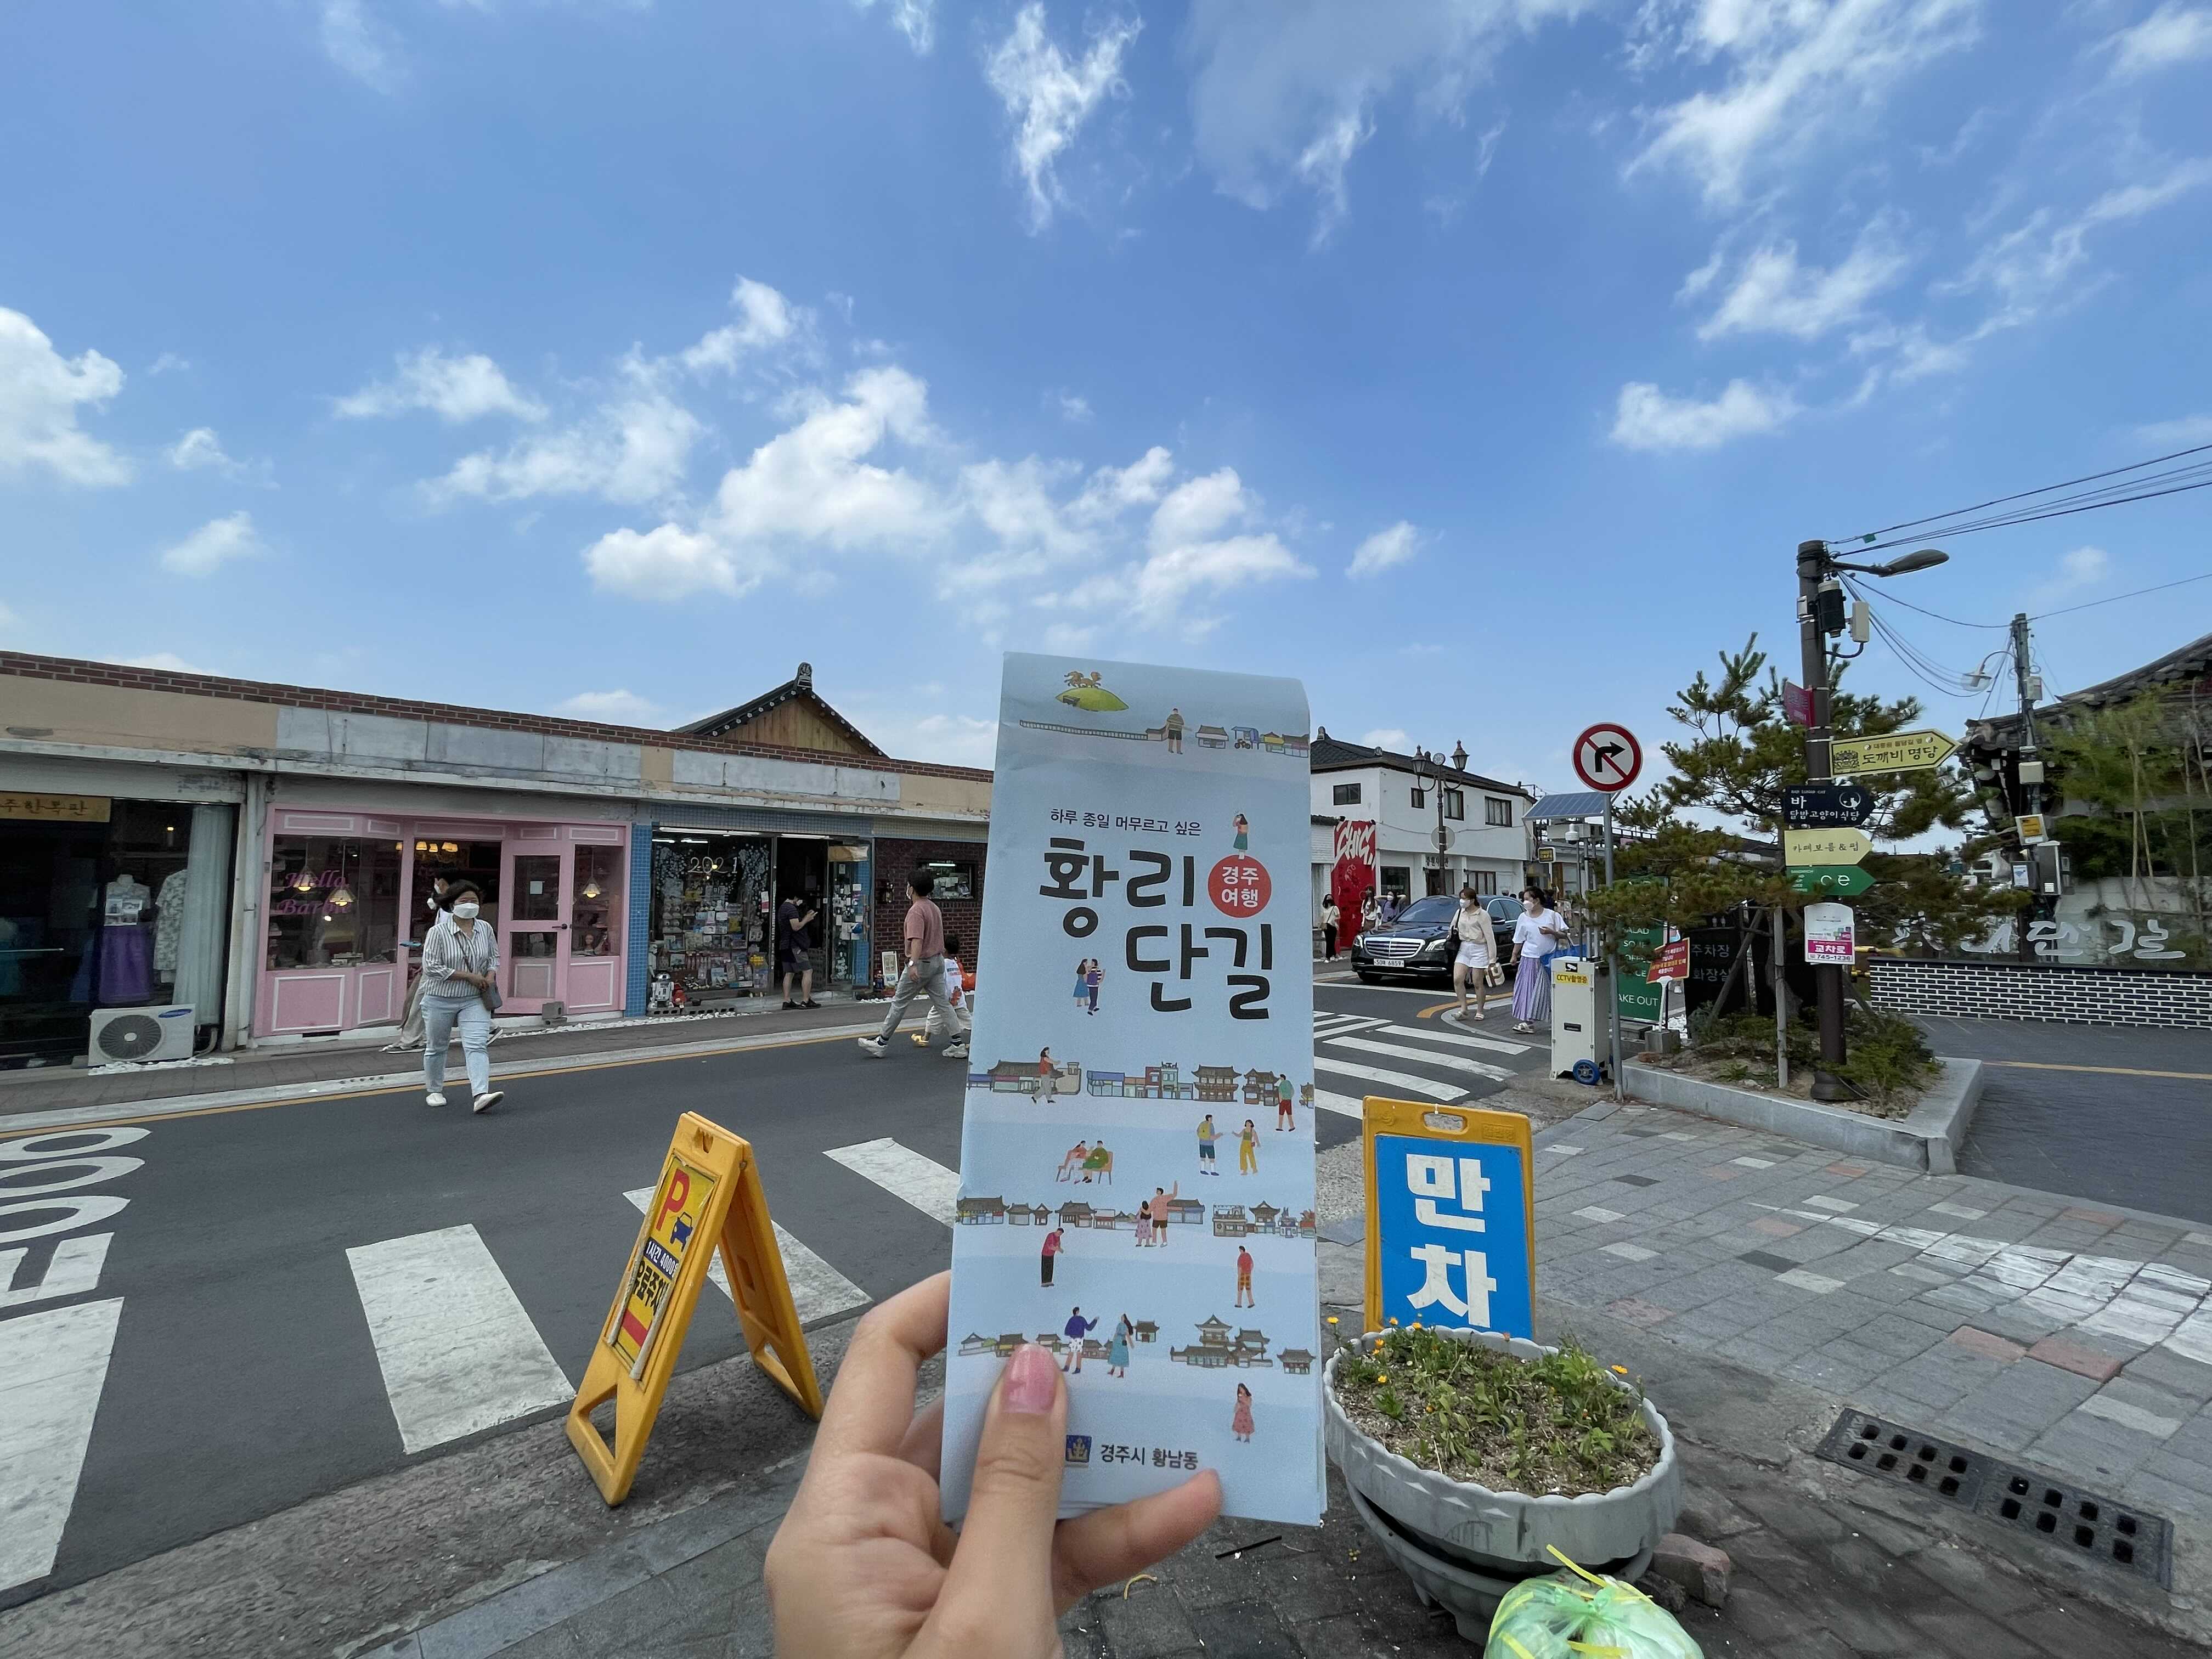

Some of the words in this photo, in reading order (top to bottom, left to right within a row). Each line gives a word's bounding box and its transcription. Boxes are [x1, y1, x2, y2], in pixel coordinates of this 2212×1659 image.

[1862, 749, 1903, 764] 도깨비
[1908, 745, 1938, 760] 명당
[1791, 795, 1807, 809] 바
[1050, 808, 1079, 825] 하루
[1082, 811, 1110, 829] 종일
[1115, 815, 1169, 834] 머무르고
[1174, 820, 1202, 837] 싶은
[687, 856, 738, 874] 2021
[1221, 865, 1260, 886] 경주
[1039, 837, 1195, 939] 황리
[1221, 887, 1259, 909] 여행
[1691, 944, 1730, 957] 주차장
[1815, 944, 1846, 954] 교차로
[1125, 923, 1273, 1020] 단길
[1618, 994, 1635, 1005] AKE
[1637, 996, 1659, 1007] OUT
[654, 1167, 691, 1232] P
[645, 1240, 662, 1263] 1시간
[1407, 1153, 1497, 1328] 만차
[1101, 1443, 1146, 1465] 경주시
[1152, 1447, 1199, 1470] 황남동
